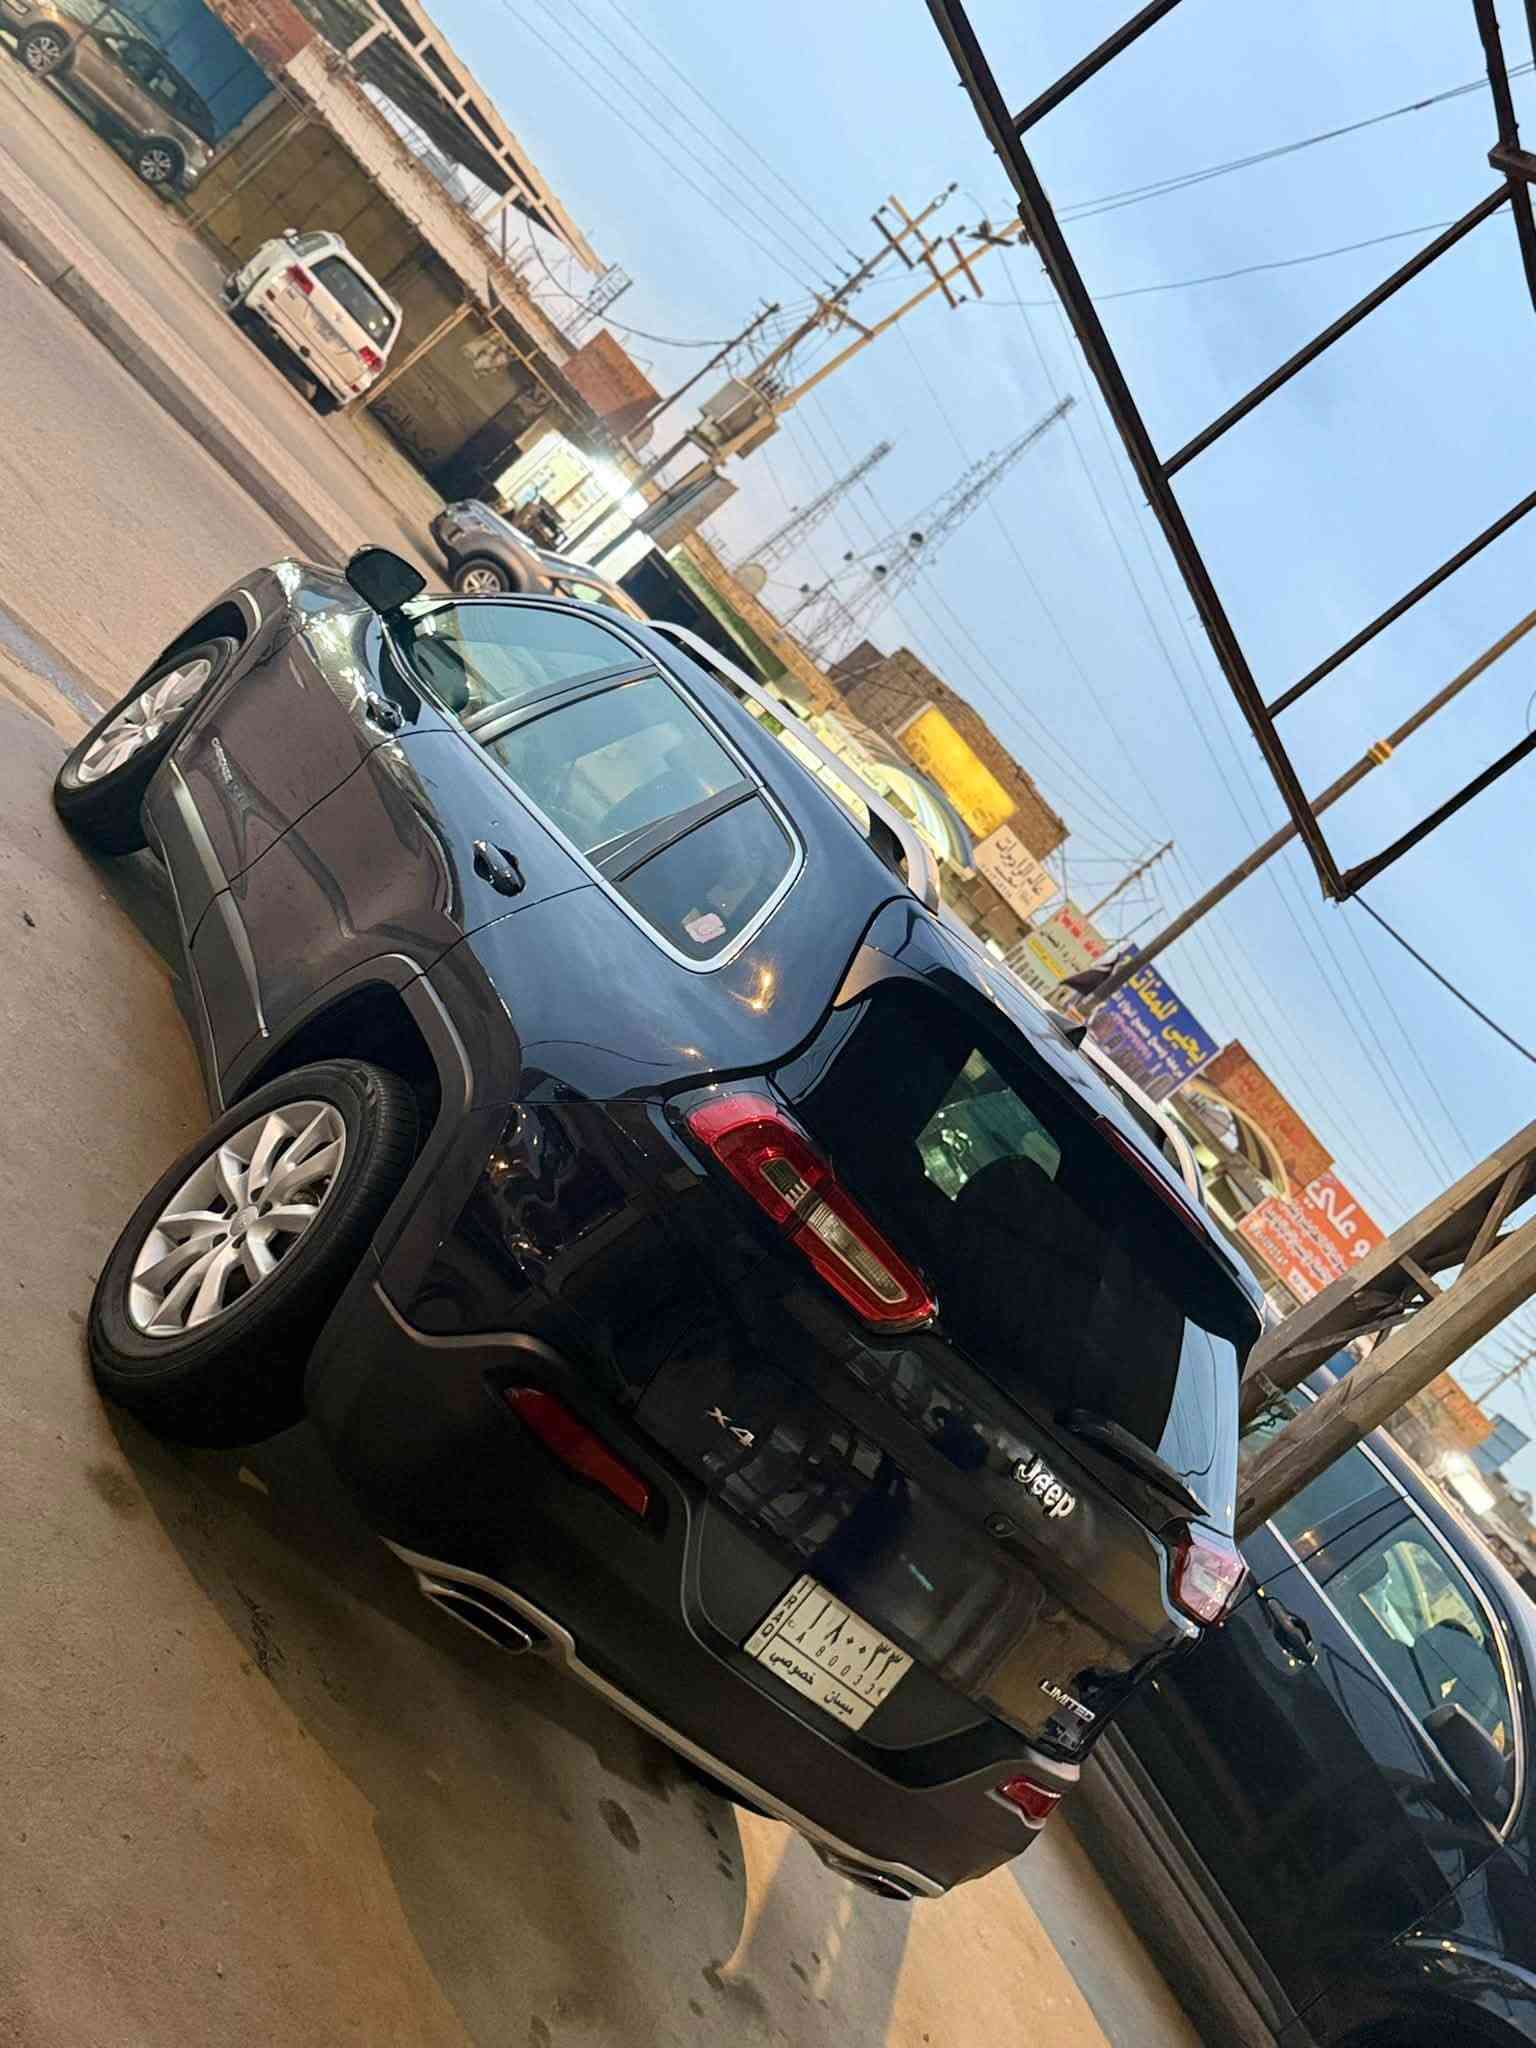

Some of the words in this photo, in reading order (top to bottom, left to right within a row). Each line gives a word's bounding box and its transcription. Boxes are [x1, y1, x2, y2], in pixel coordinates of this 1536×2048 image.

[1305, 1180, 1358, 1240] علي
[1016, 1458, 1075, 1518] Jeep
[761, 1580, 809, 1638] IRAQ
[823, 1690, 855, 1715] ميسان
[1040, 1680, 1096, 1722] LIMITED
